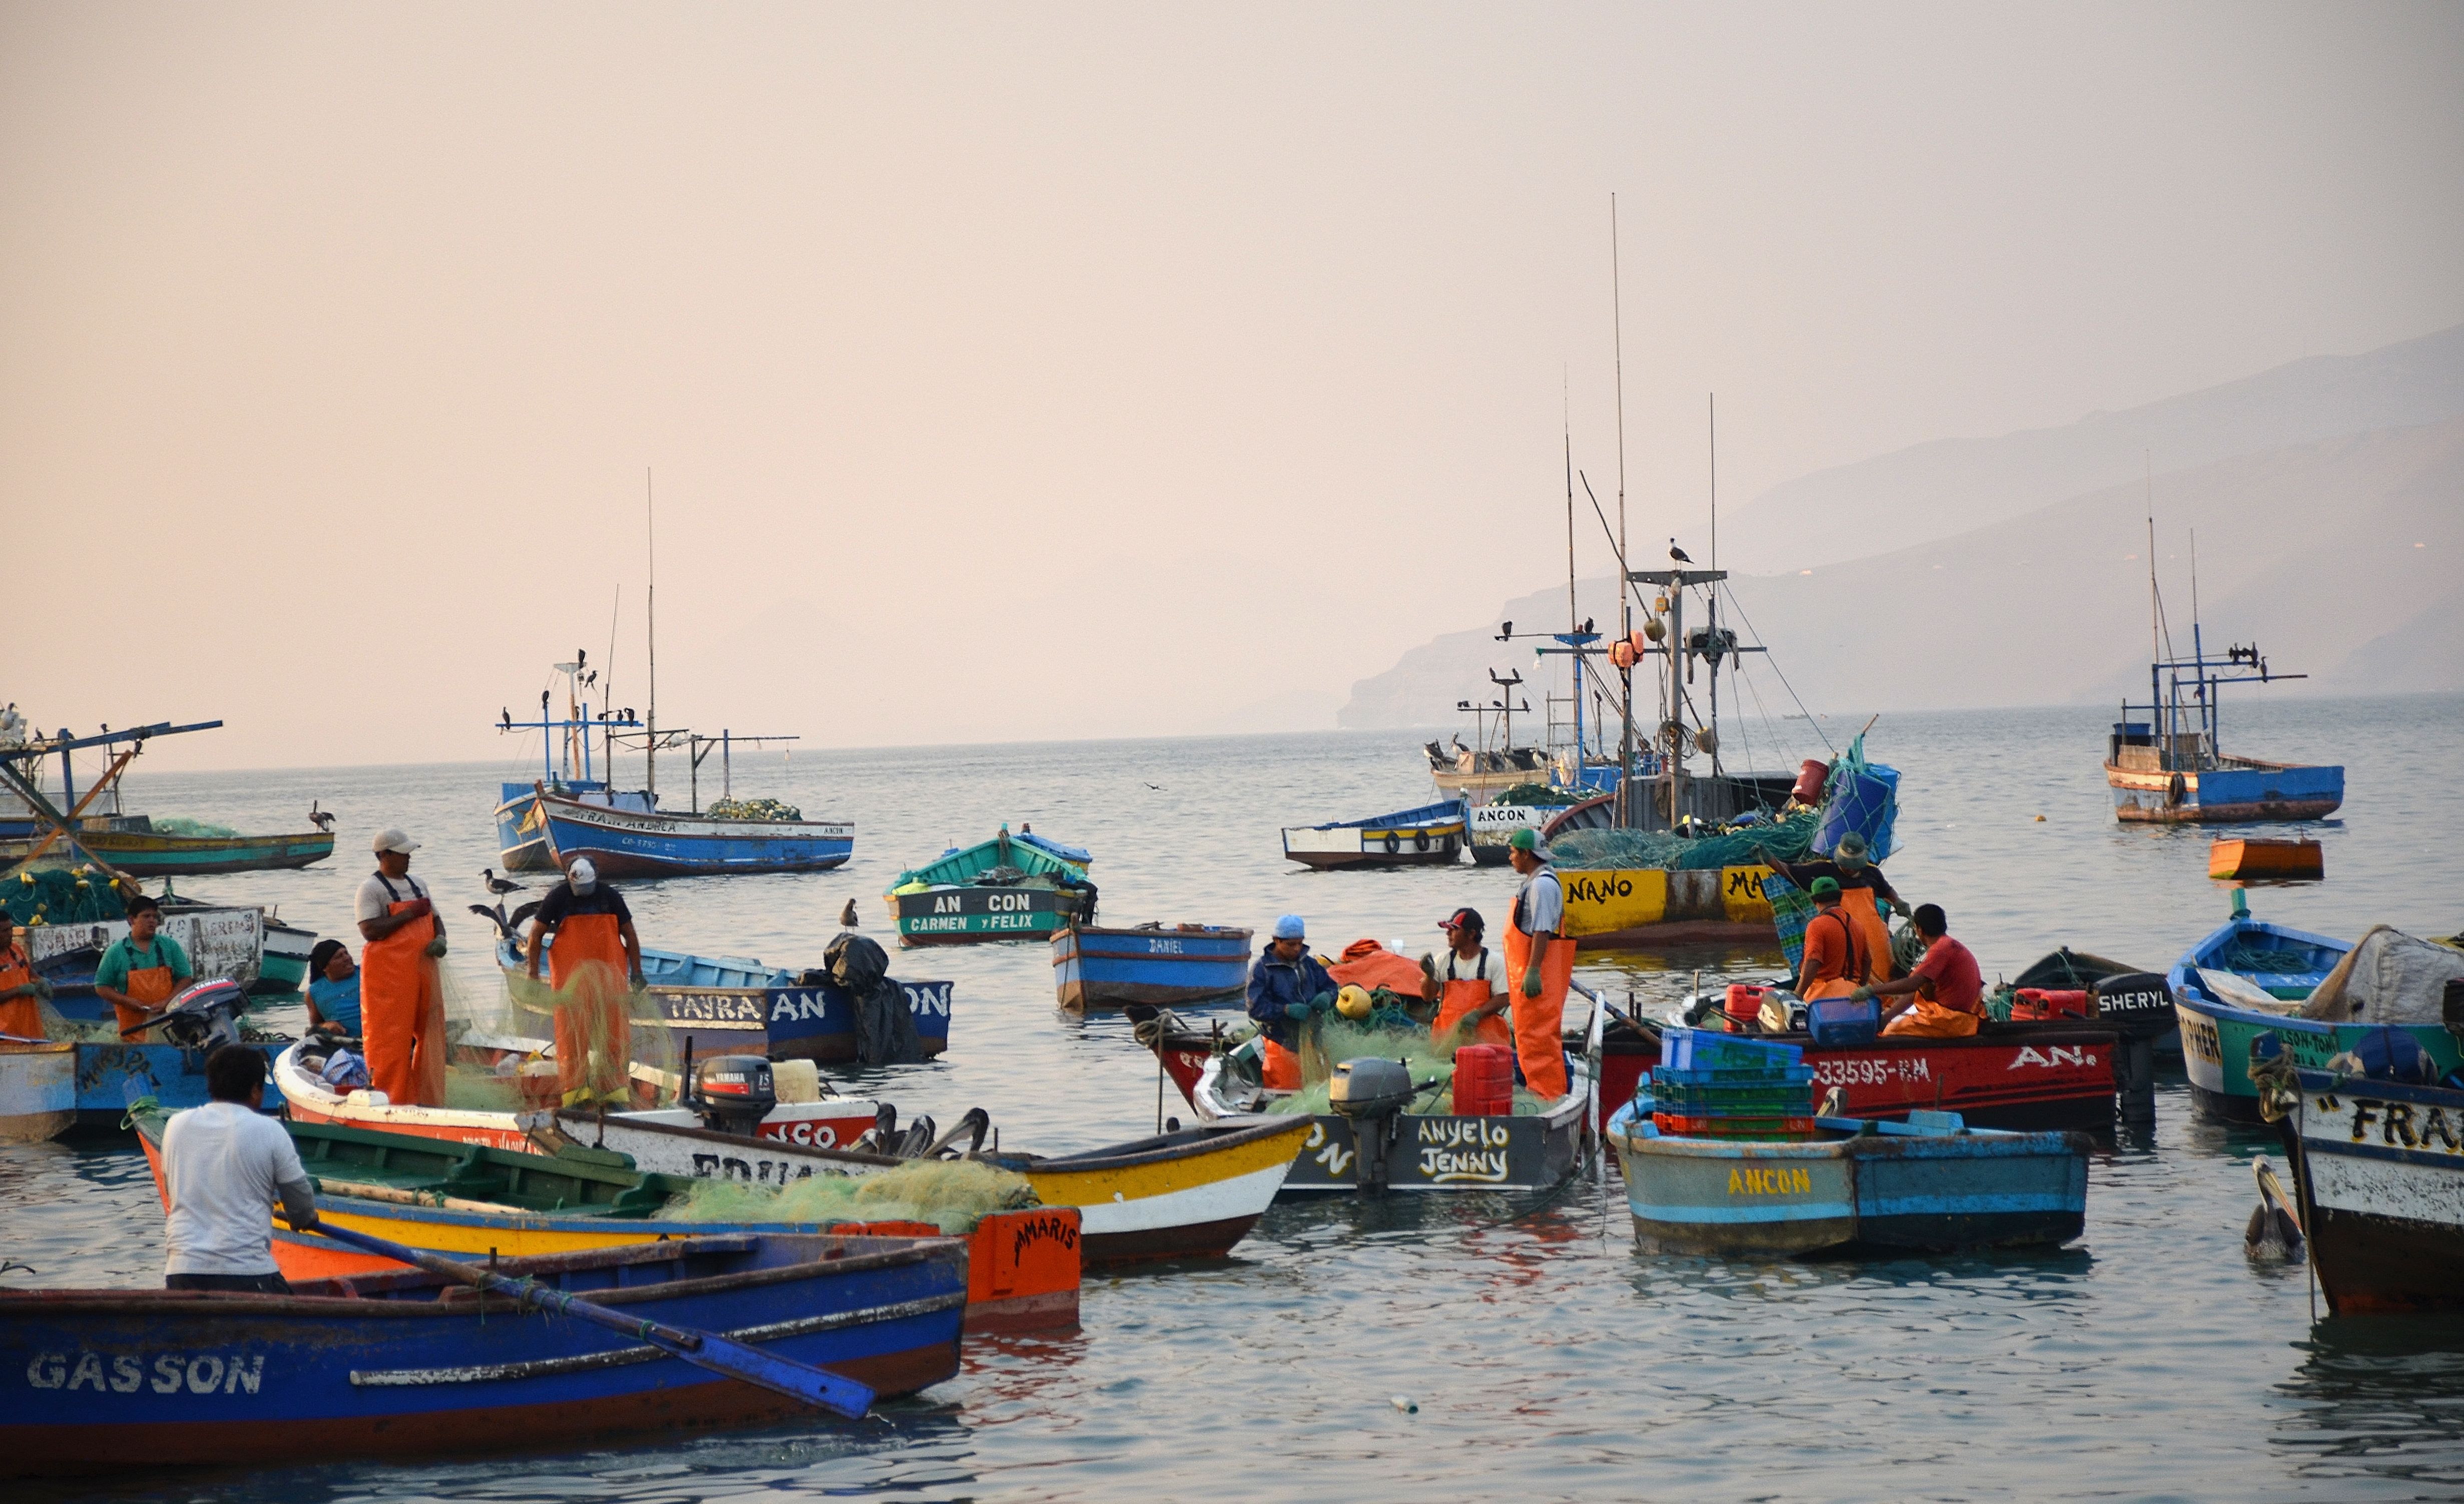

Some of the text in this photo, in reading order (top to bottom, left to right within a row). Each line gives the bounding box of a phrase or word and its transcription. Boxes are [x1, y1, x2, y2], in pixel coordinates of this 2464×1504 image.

[1477, 810, 1527, 822] ANCON
[1566, 871, 1776, 904] NANO MA
[934, 894, 1030, 913] AN CON
[910, 917, 968, 931] CARMEN
[991, 914, 1033, 929] FELIX
[2099, 990, 2169, 1012] SHERYL
[716, 1072, 745, 1083] YAMAHA
[758, 1073, 769, 1086] 15
[1419, 1149, 1508, 1183] JENNY
[1728, 1168, 1811, 1194] ANCON
[27, 1353, 265, 1394] GASSON
